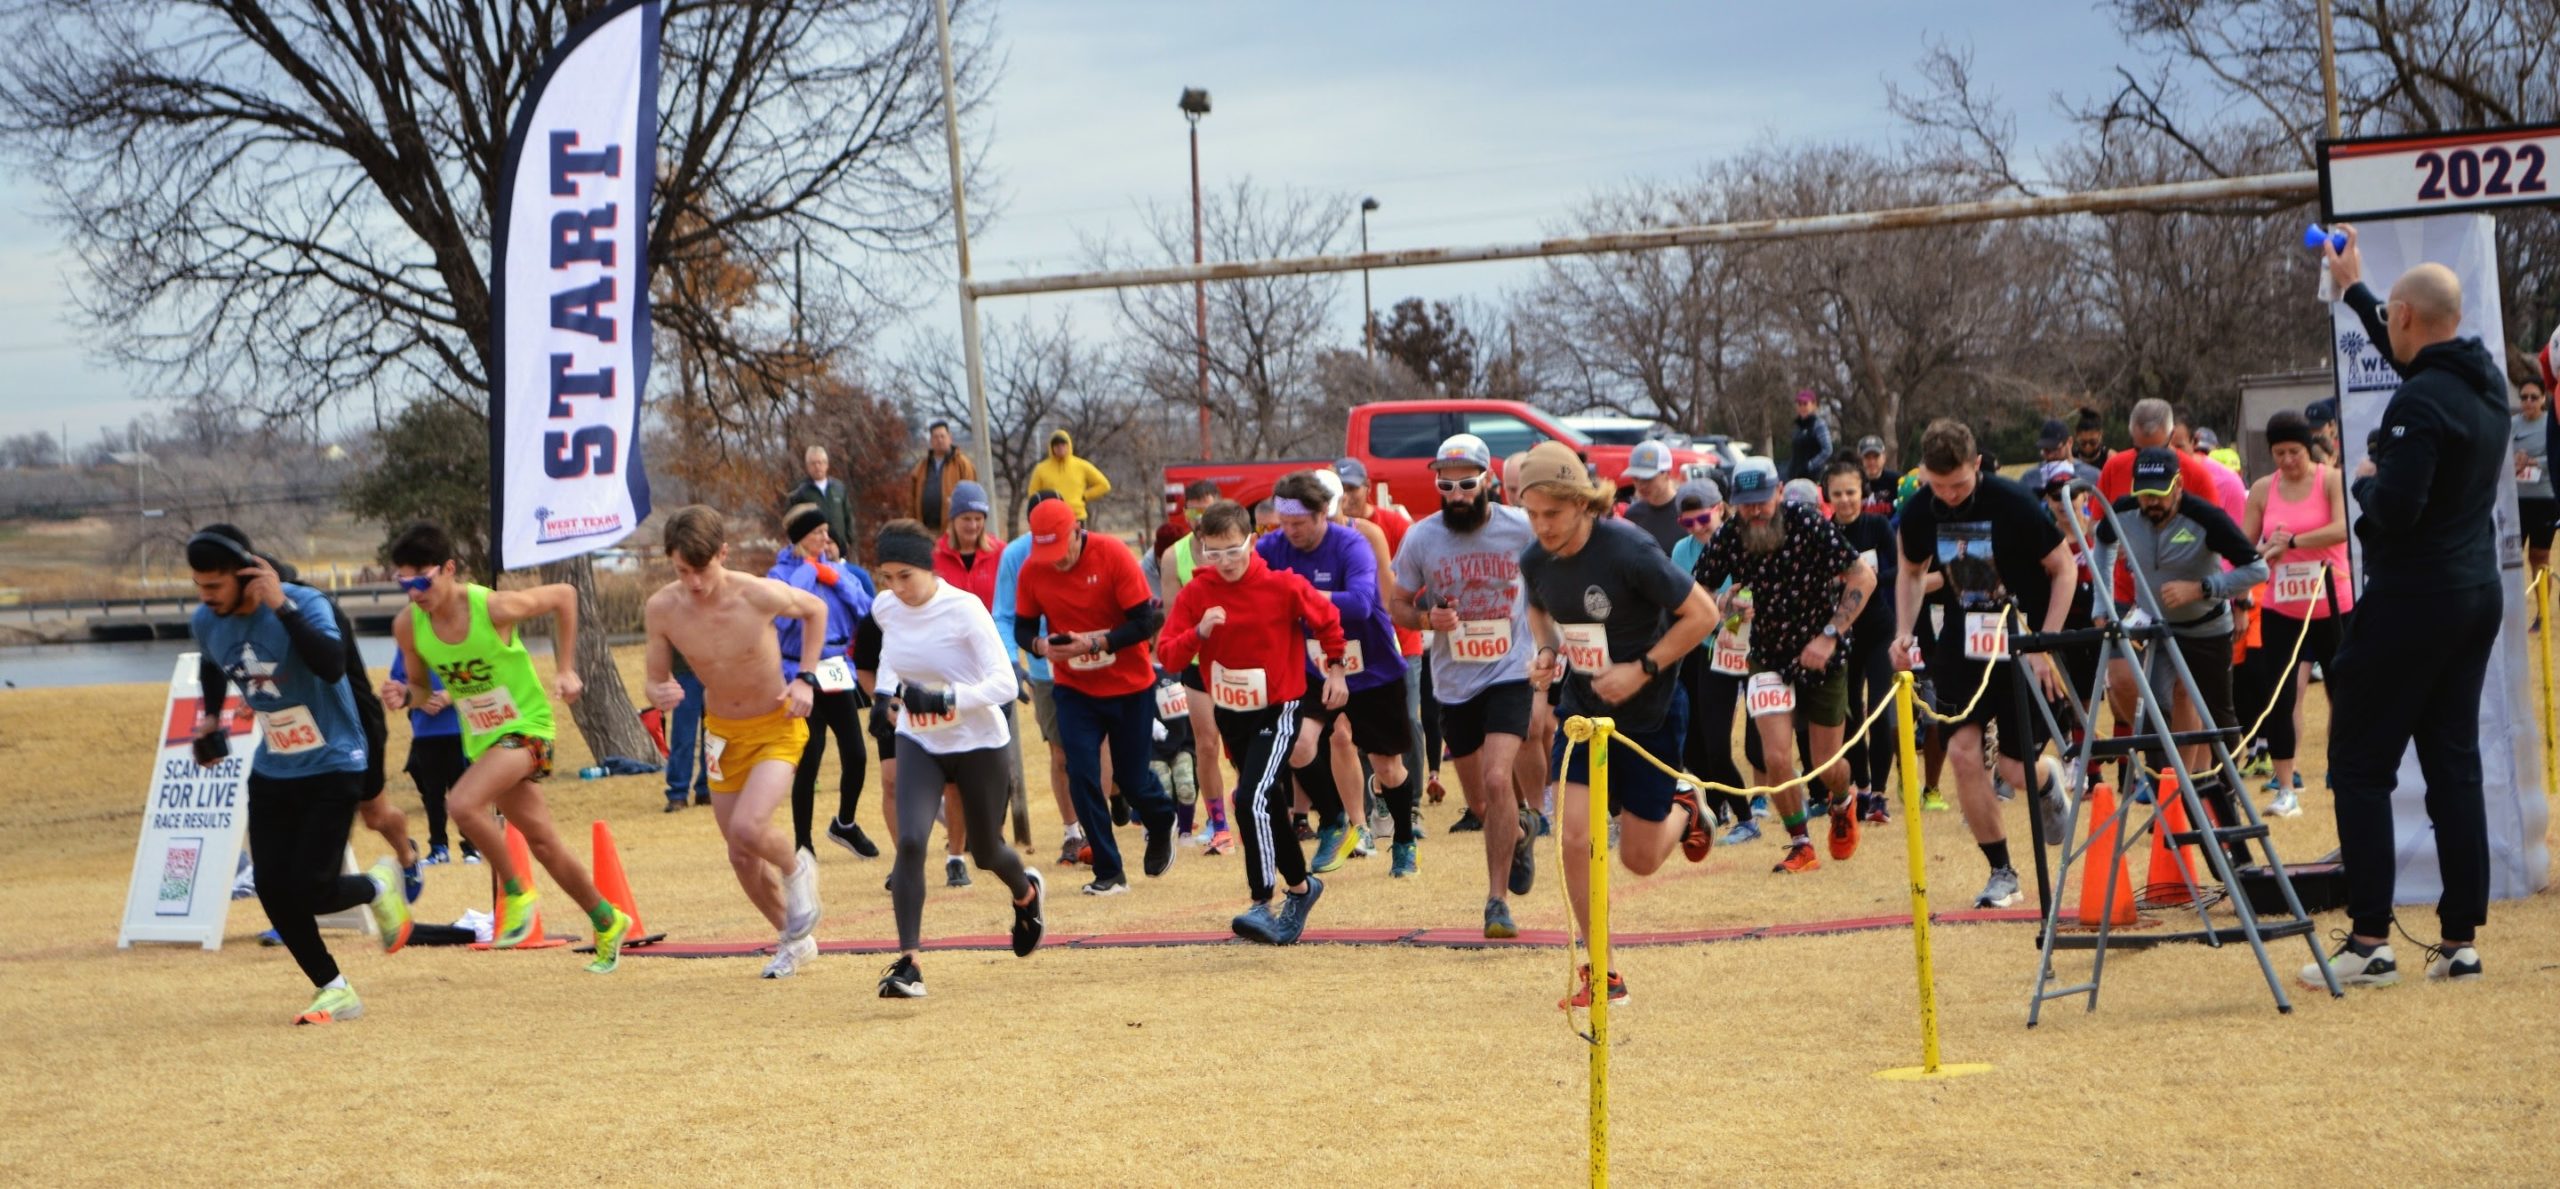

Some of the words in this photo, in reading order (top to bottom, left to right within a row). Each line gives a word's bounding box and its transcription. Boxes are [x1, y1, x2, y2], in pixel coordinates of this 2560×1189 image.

[2415, 143, 2546, 201] 2022
[543, 130, 622, 480] START
[546, 517, 577, 530] WEST
[582, 513, 620, 527] TEXAS
[1455, 637, 1508, 657] 1060
[1970, 632, 2006, 654] 101
[1716, 651, 1750, 671] 105
[1214, 683, 1260, 706] 1061
[1750, 688, 1793, 712] 1064
[268, 724, 317, 750] 1043
[164, 759, 201, 780] SCAN
[203, 757, 244, 779] HERE
[158, 783, 194, 809] FOR
[196, 782, 239, 808] LIVE
[153, 813, 181, 830] RACE
[182, 812, 232, 829] RESULTS
